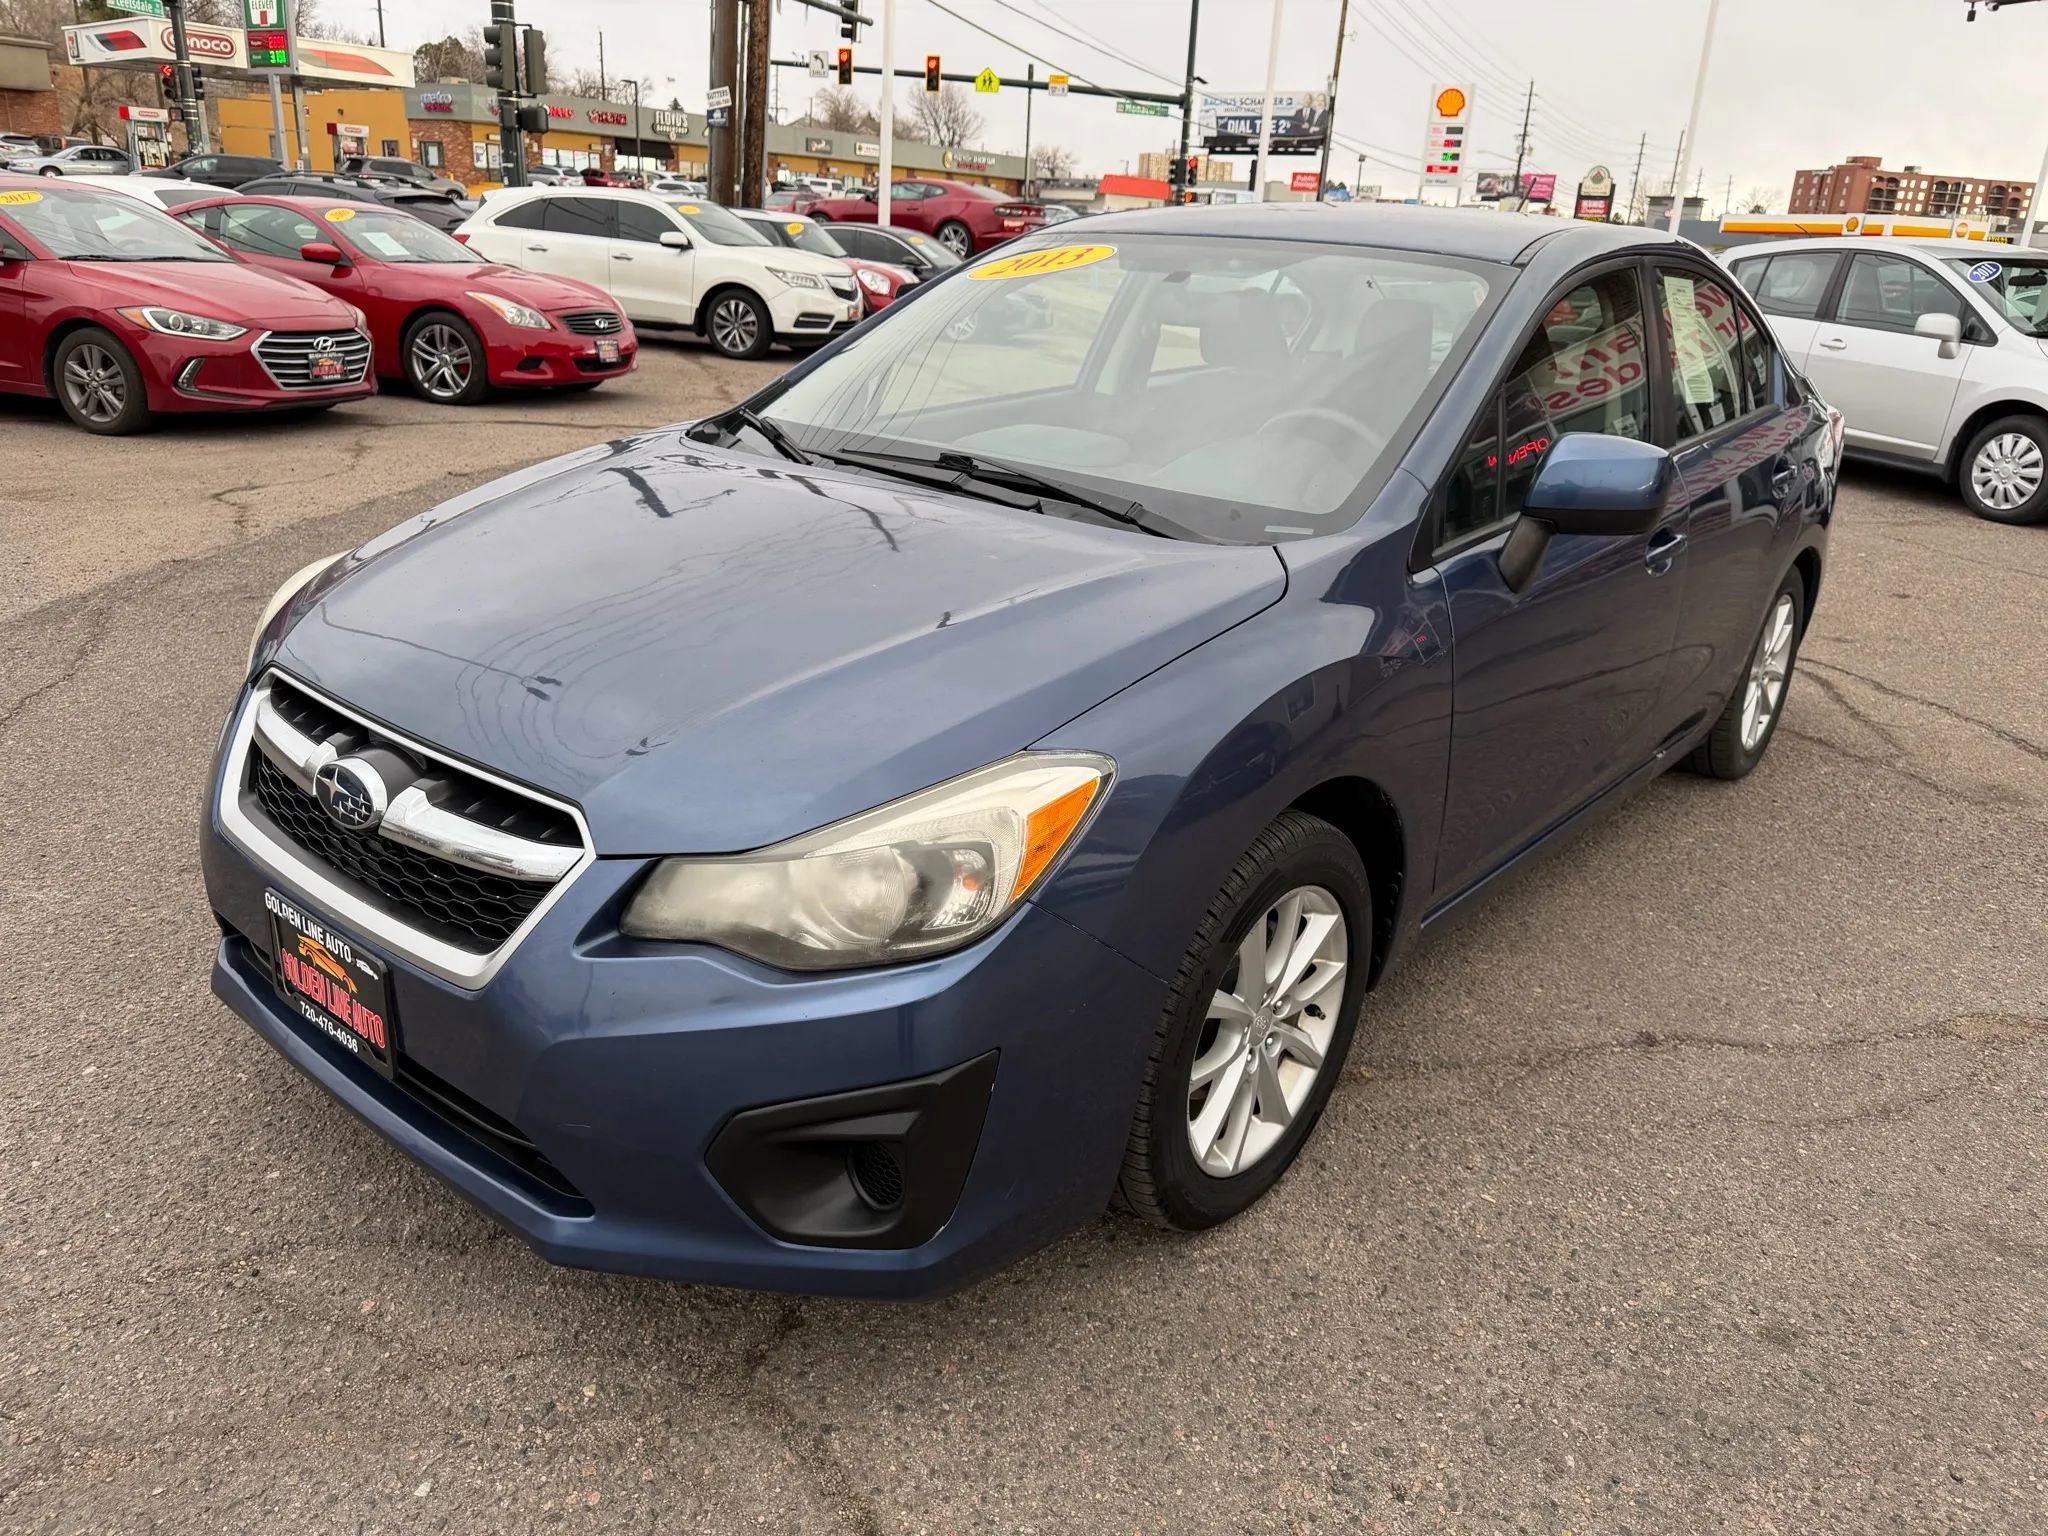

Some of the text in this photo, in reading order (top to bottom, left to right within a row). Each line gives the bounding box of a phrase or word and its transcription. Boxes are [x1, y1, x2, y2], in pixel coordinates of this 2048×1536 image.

[1227, 119, 1253, 134] DIAL
[1255, 119, 1276, 134] TE
[989, 247, 1094, 276] 2013
[1972, 263, 1997, 281] 2011
[264, 891, 352, 963] GOLDEN LINE AUTO
[281, 947, 386, 1049] GOLDEN LINE AUTO
[299, 1000, 359, 1054] 720-476-4036
